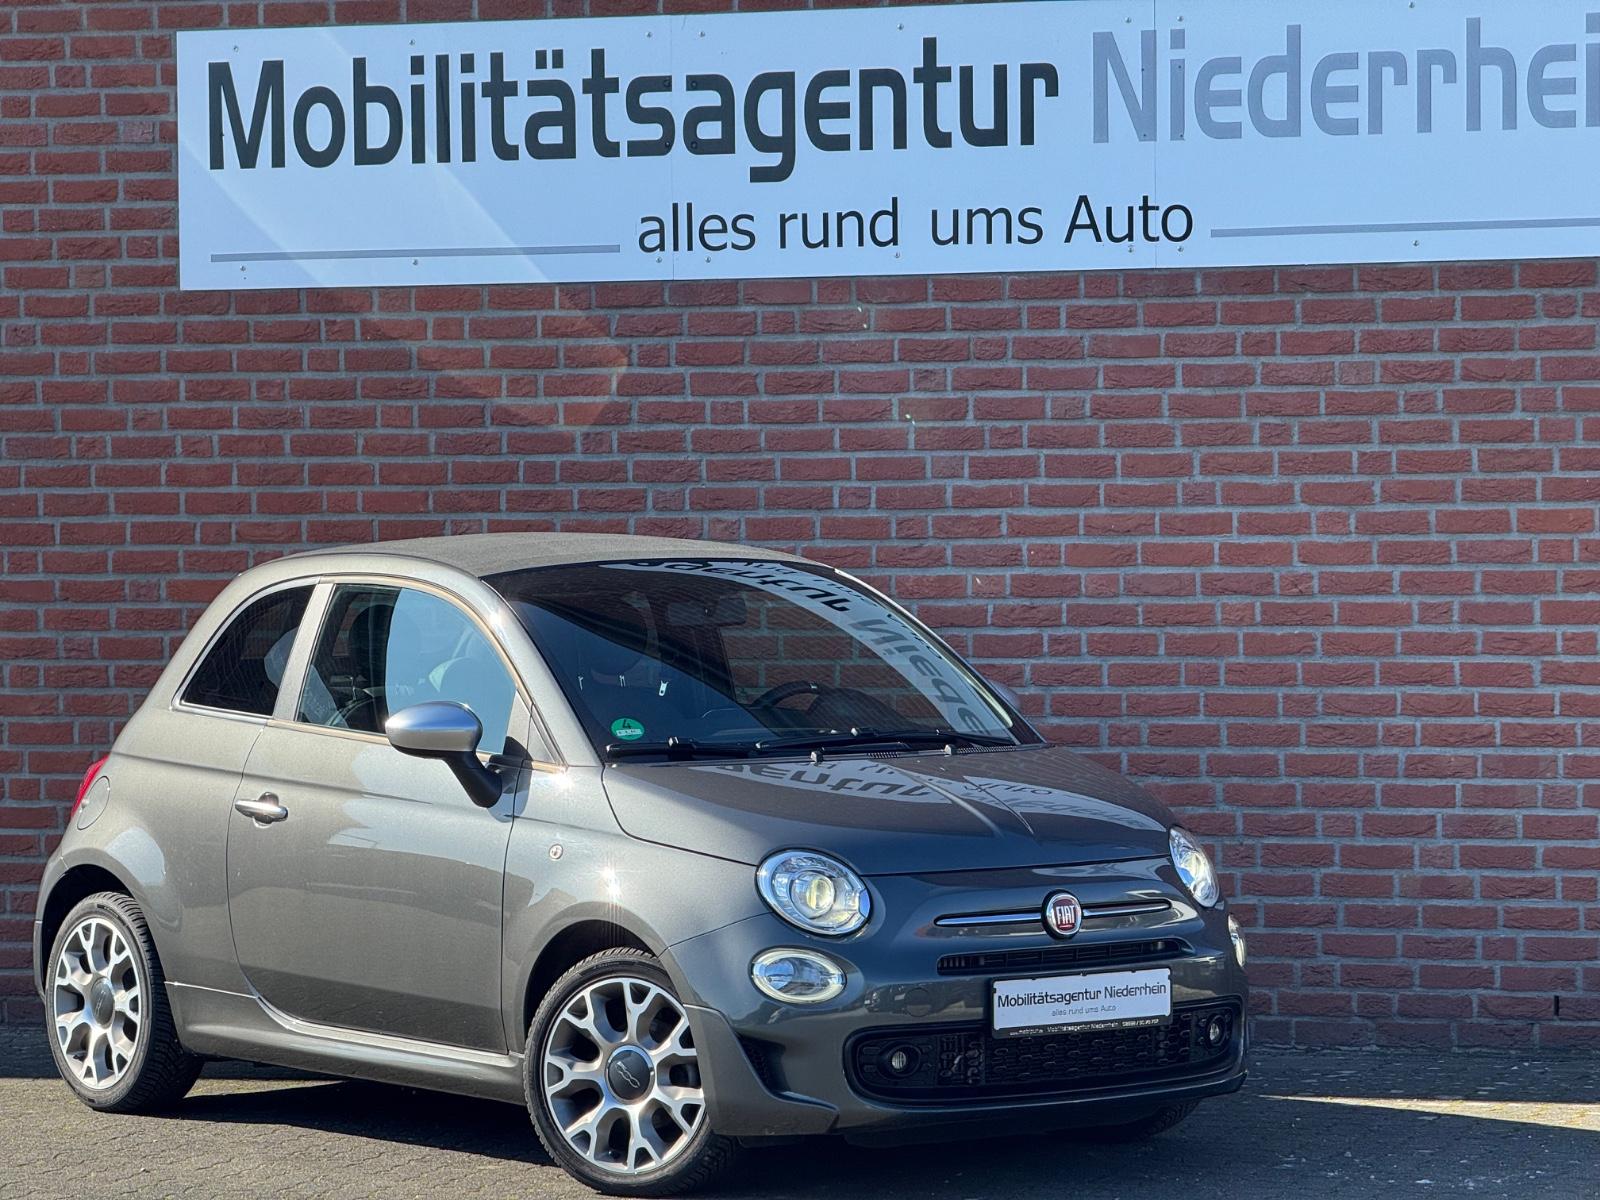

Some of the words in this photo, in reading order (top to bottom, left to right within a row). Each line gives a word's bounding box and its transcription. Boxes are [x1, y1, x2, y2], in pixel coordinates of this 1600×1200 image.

[208, 37, 1060, 183] Mobilitätsagentur
[1092, 13, 1600, 143] Niederrhei
[638, 202, 756, 253] alles
[779, 197, 899, 249] rund
[930, 206, 1043, 246] ums
[1064, 195, 1194, 244] Auto
[1056, 905, 1075, 925] FIAT
[997, 988, 1102, 1008] Mobilitätsagentur
[1104, 981, 1166, 999] Niederrhein
[1068, 1006, 1083, 1015] rund
